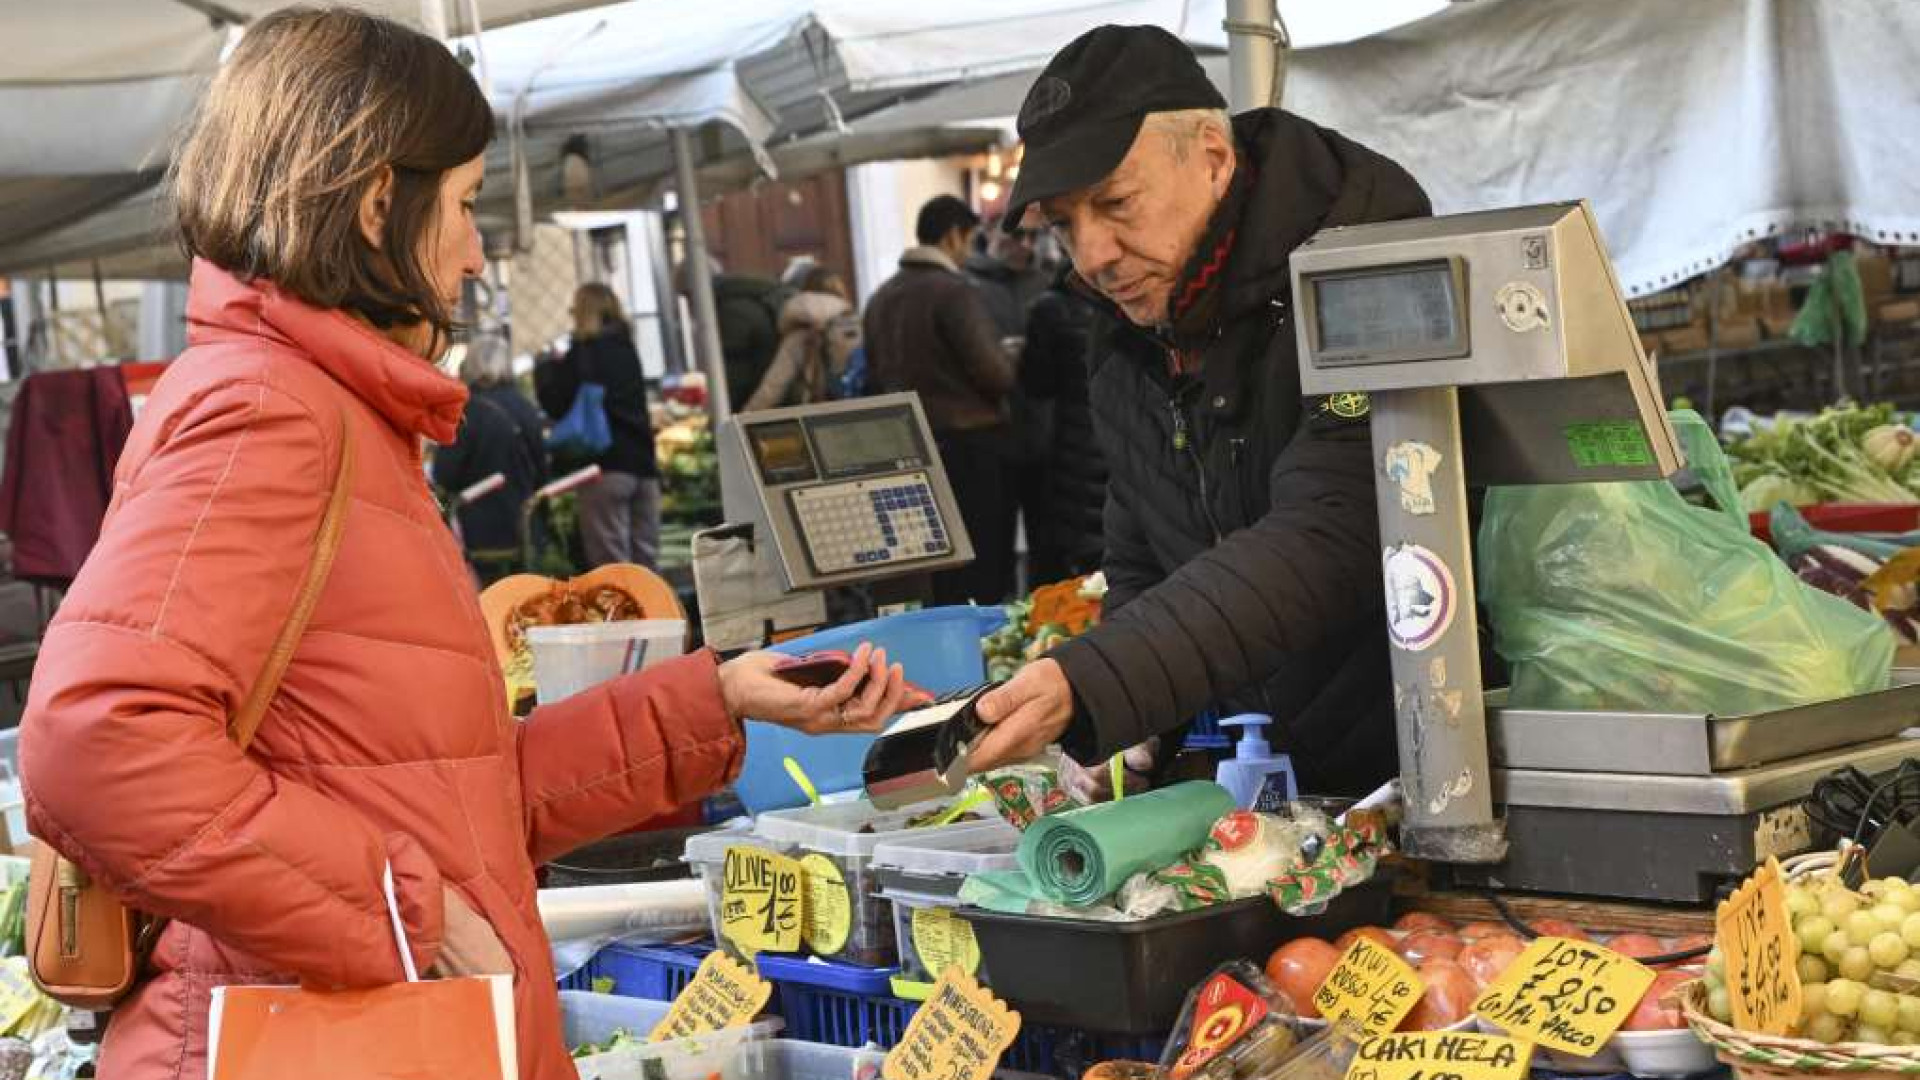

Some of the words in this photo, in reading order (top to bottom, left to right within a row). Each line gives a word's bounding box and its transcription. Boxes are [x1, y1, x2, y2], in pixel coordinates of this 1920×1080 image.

[724, 849, 772, 889] OLIVE
[1534, 940, 1609, 978] LOTI
[1358, 1035, 1426, 1062] CAKI
[1432, 1035, 1517, 1068] MELA
